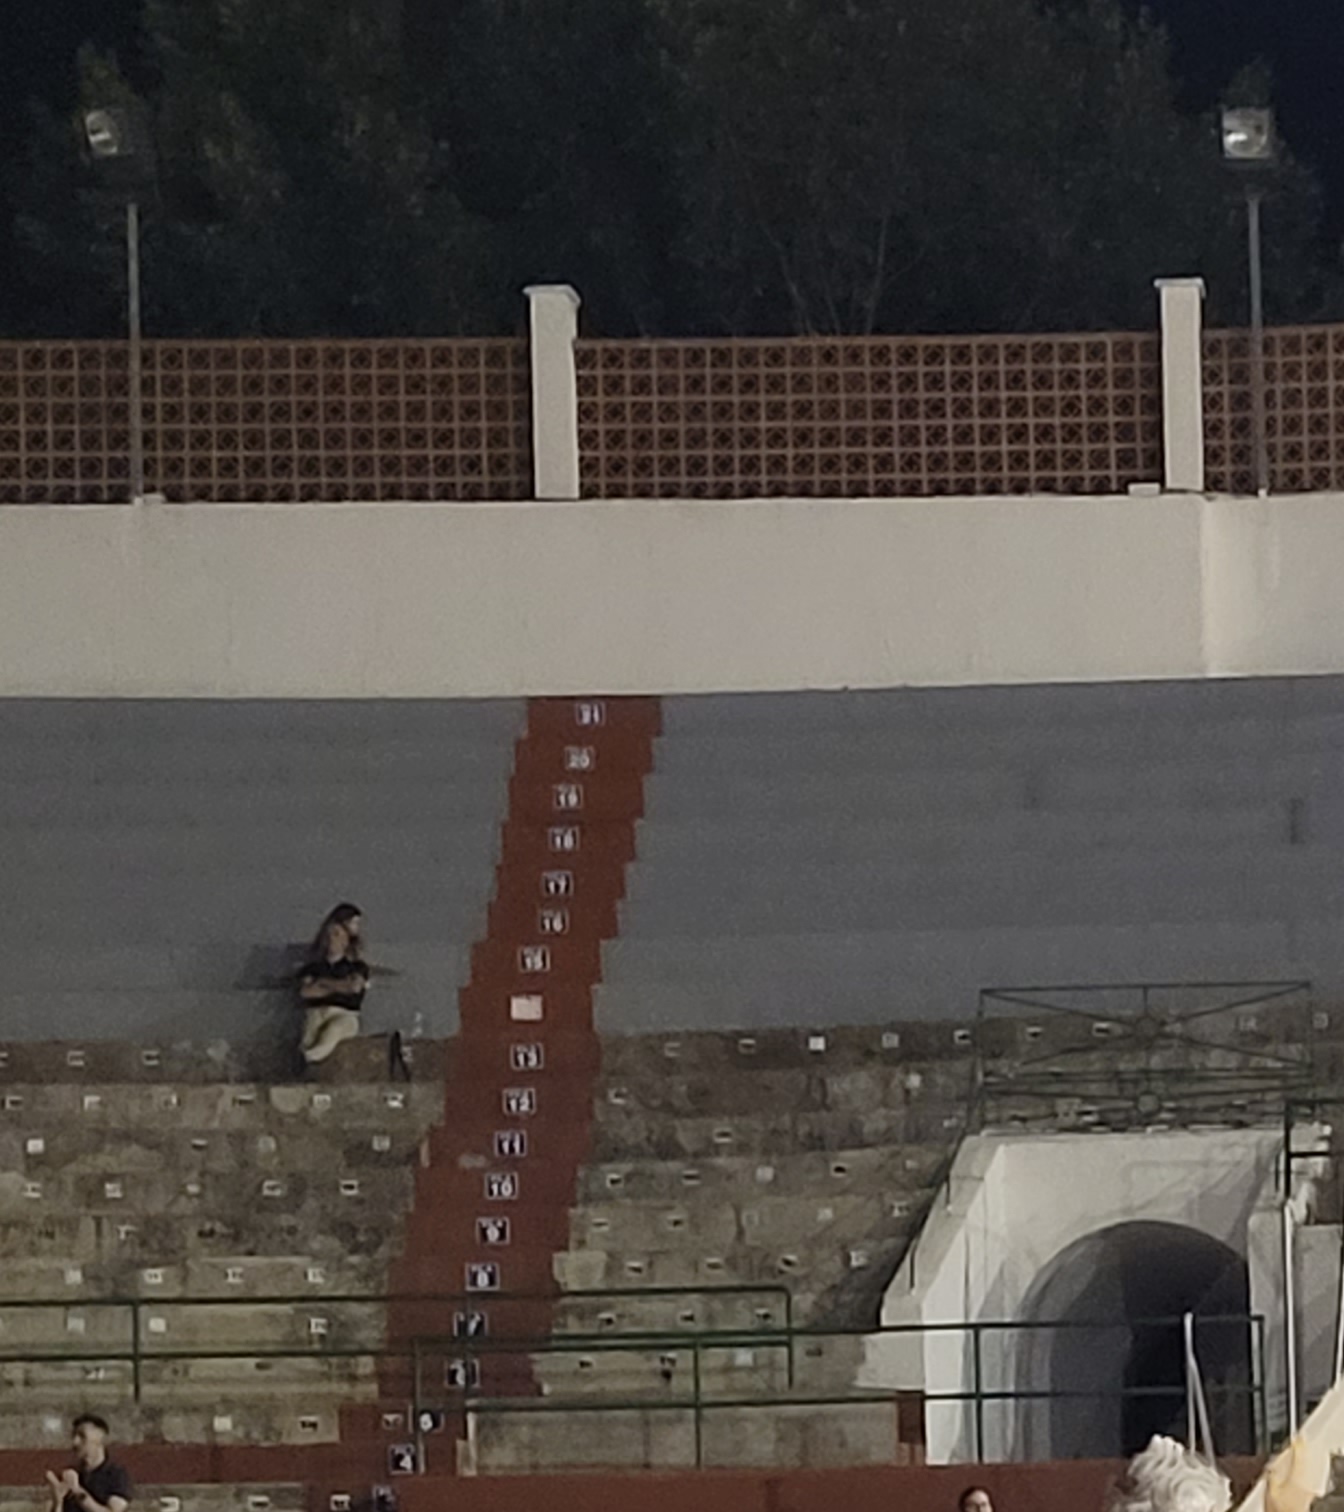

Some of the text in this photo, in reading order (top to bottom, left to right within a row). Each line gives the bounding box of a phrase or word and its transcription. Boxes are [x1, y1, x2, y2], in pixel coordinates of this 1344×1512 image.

[548, 880, 567, 895] 17
[509, 1098, 530, 1113] 12
[502, 1139, 520, 1155] 11
[491, 1182, 513, 1197] 10
[399, 1454, 412, 1471] 4
